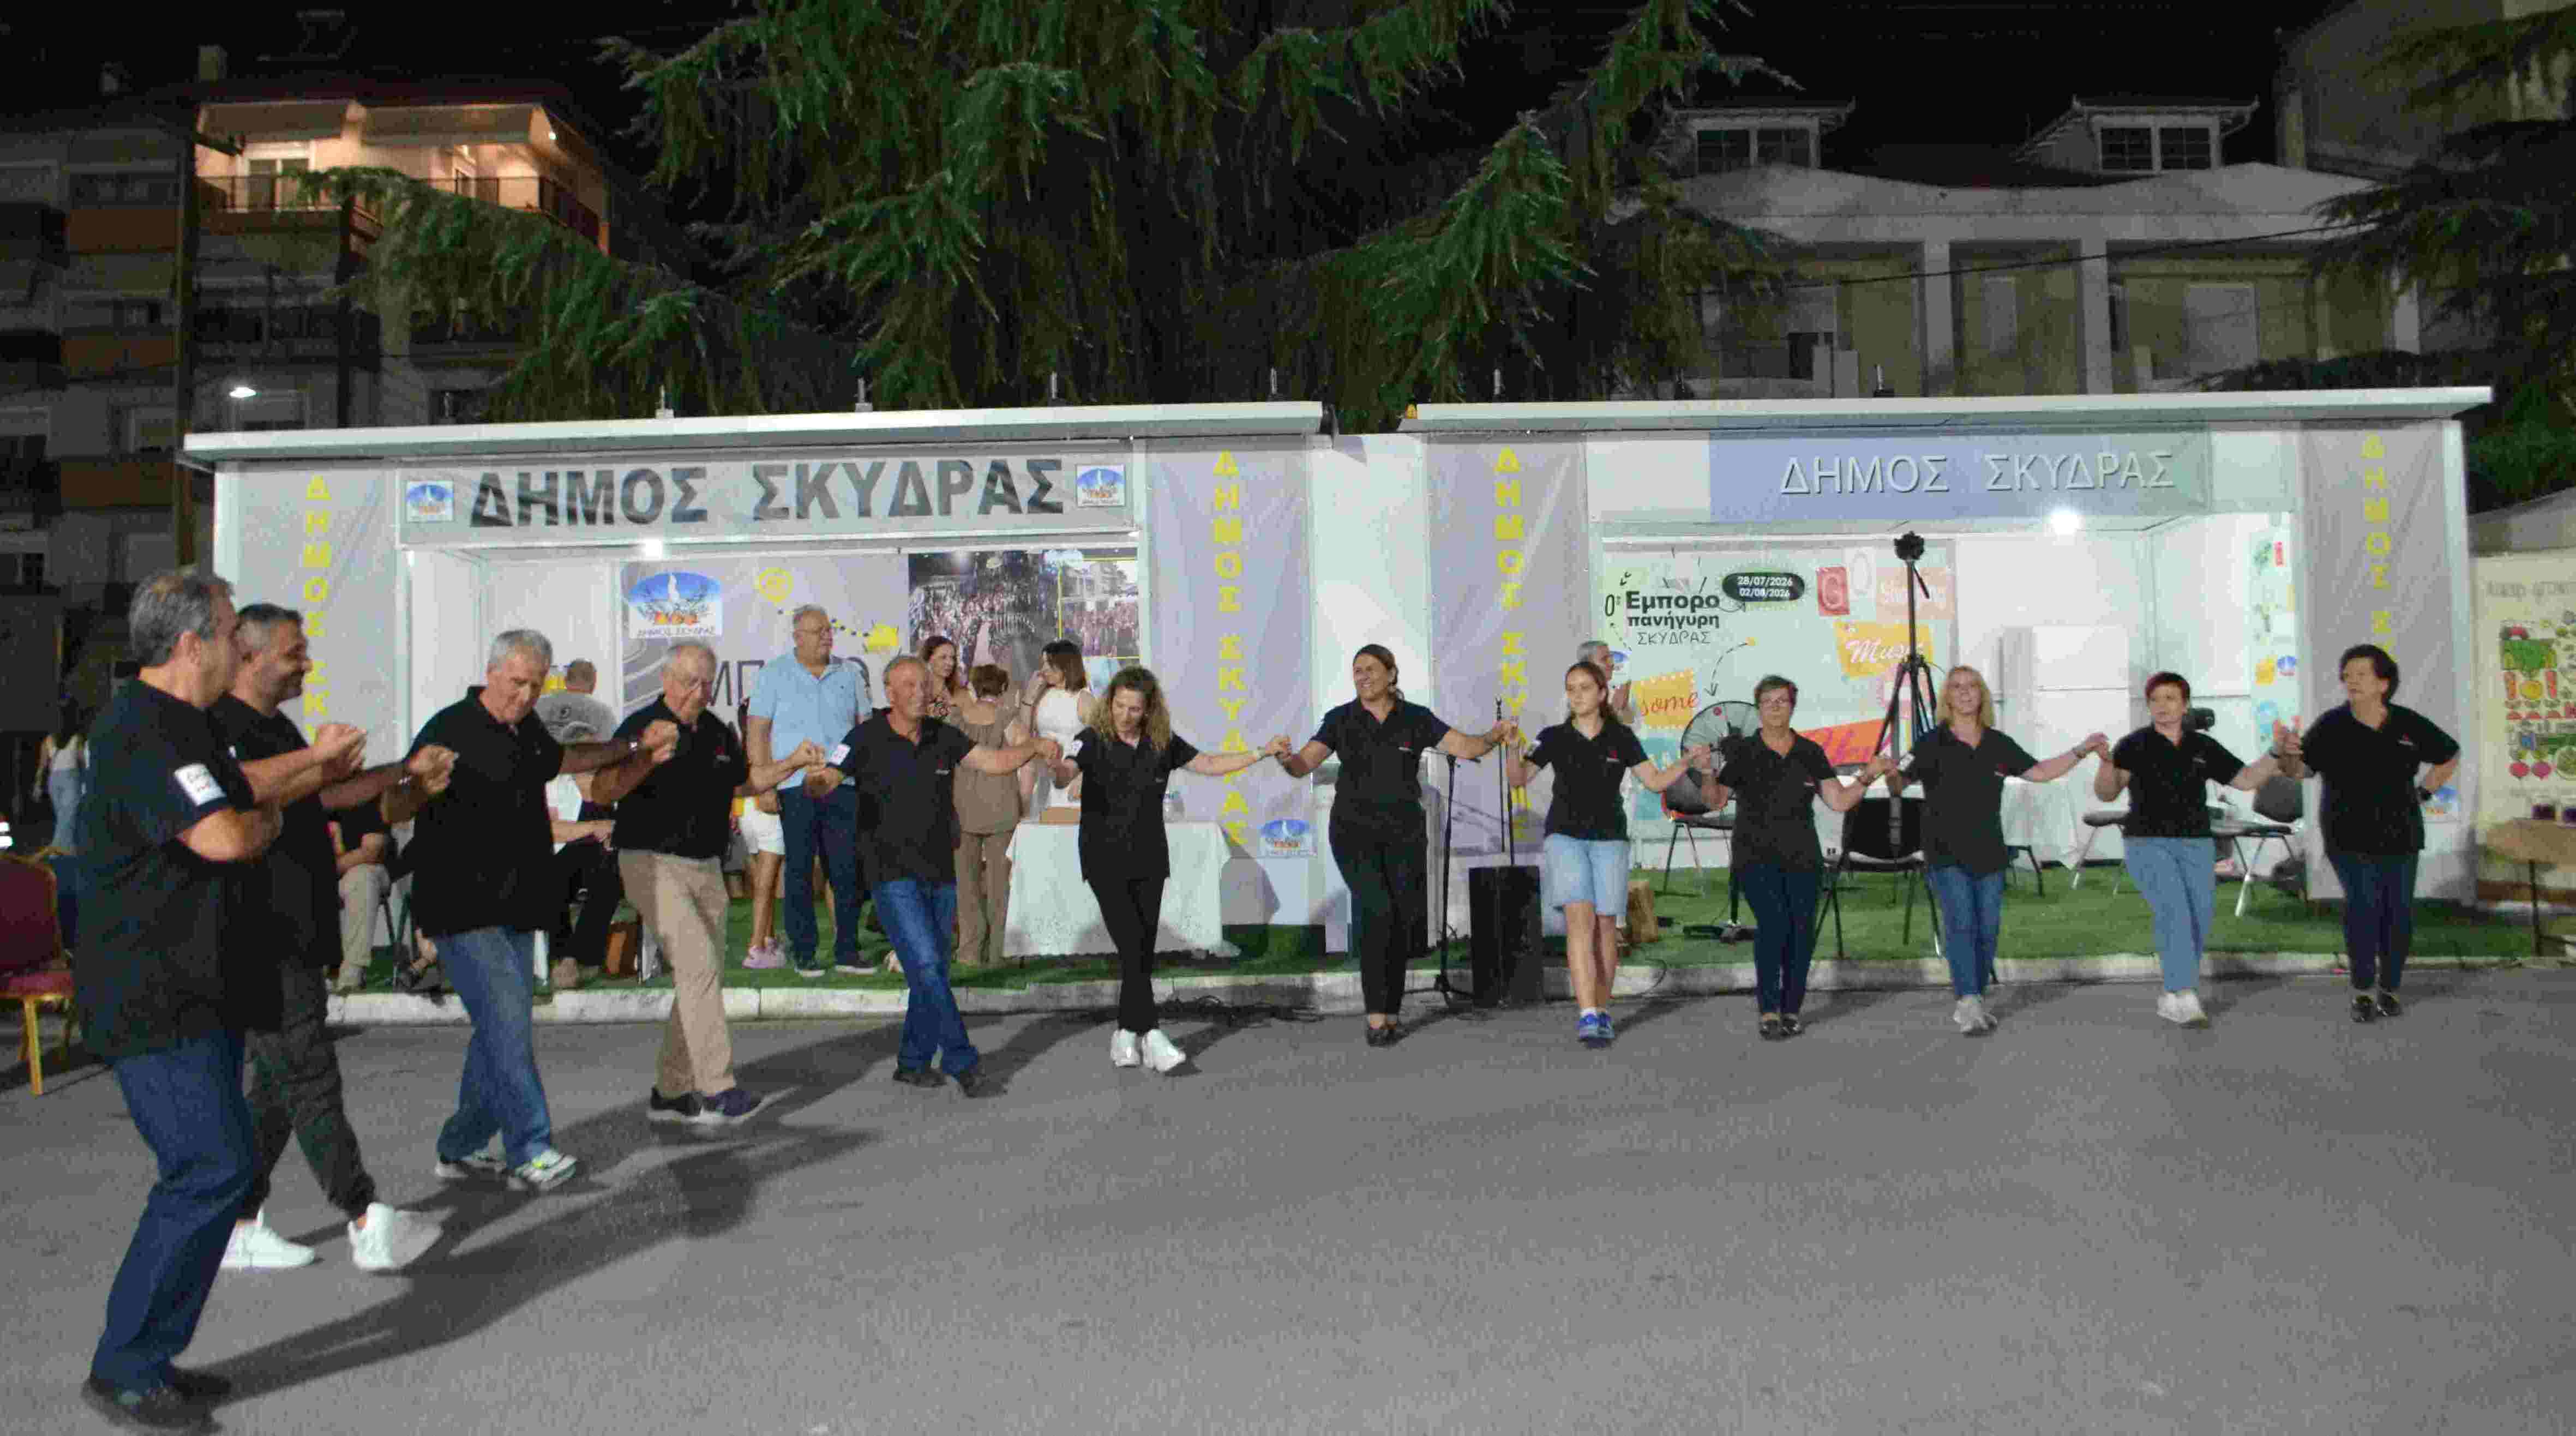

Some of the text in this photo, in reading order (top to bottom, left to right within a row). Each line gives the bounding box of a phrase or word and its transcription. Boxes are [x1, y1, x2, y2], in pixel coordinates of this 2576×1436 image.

[471, 458, 1064, 527] ΔΗΜΟΣ ΣΚΥΔΡΑΣ
[1780, 450, 2175, 495] ΔΗΜΟΣ ΣΚΥΔΡΑΣ
[1214, 450, 1244, 612] ΔΗΜΟΣ
[1494, 446, 1524, 611] ΔΗΜΟΣ
[2359, 429, 2392, 591] ΔΗΜΟΣ
[303, 475, 332, 638] ΔΗΜΟΣ
[1625, 591, 1720, 614] Εμπορο
[1628, 610, 1720, 629] πανήγυρη
[1637, 630, 1710, 645] ΣΚΥΔΡΑΣ
